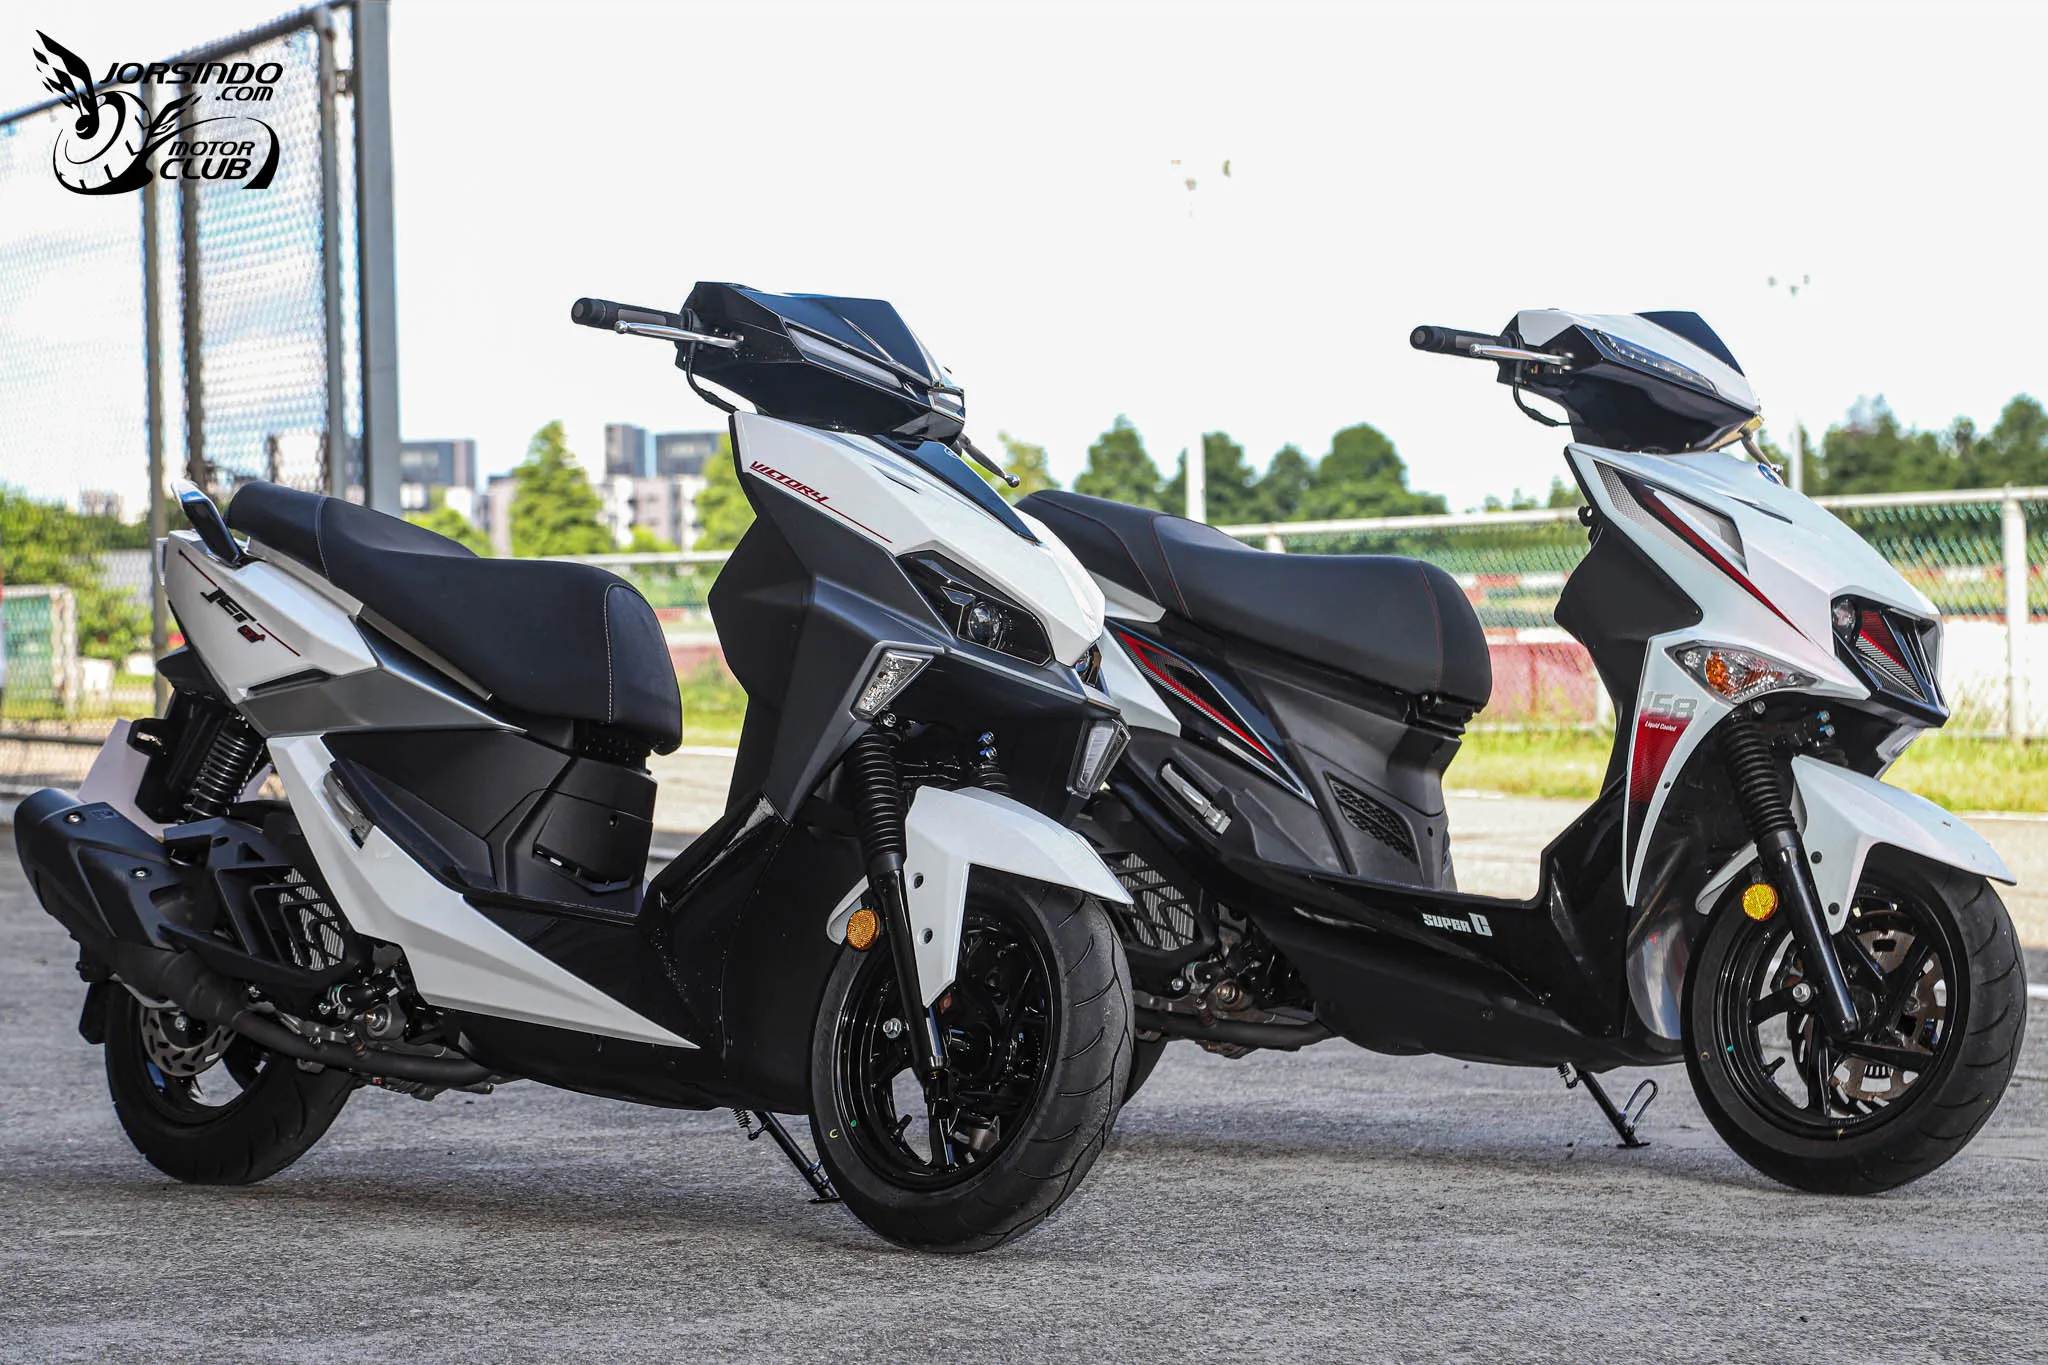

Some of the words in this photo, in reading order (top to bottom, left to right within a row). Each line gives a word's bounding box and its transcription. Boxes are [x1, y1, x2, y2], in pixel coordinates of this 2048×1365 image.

[200, 586, 257, 623] JET
[1644, 720, 1660, 729] Liquid
[1422, 912, 1472, 932] SUPER
